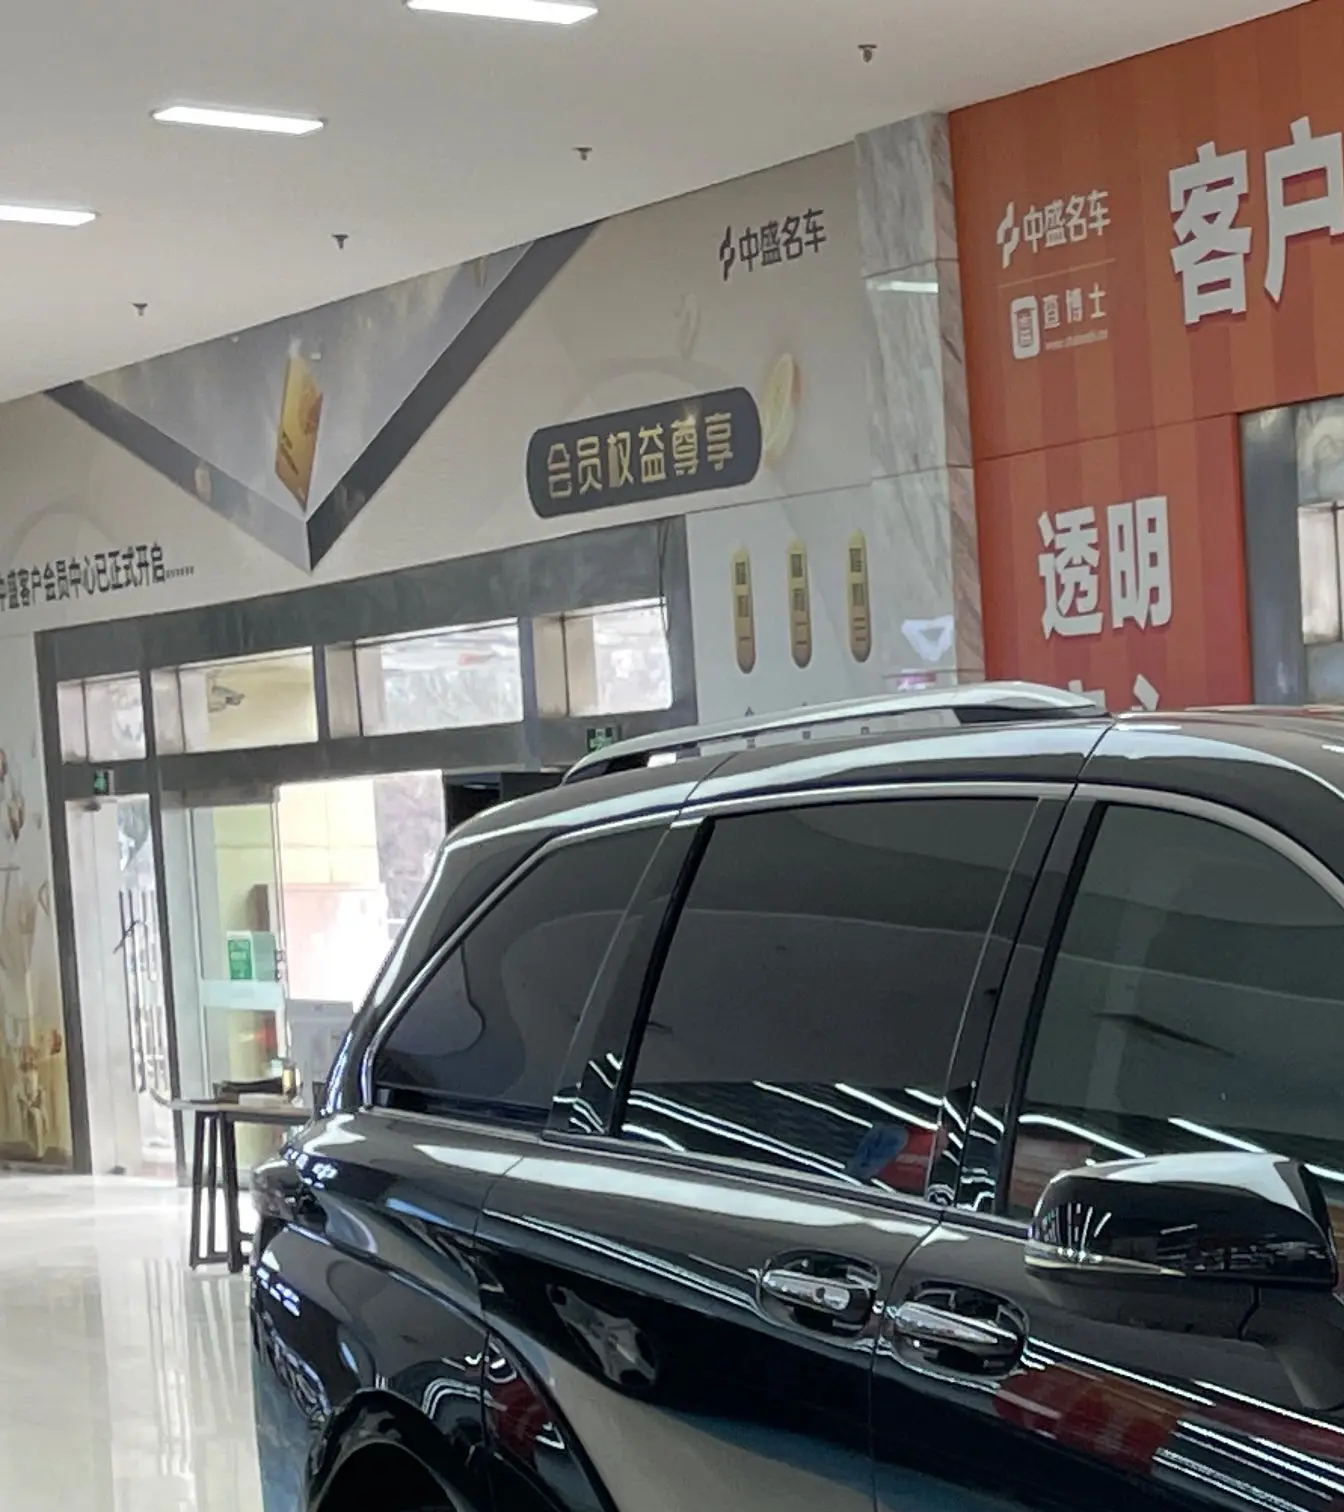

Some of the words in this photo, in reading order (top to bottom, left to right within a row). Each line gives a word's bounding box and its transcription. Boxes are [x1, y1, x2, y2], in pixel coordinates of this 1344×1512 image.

[739, 208, 827, 272] 中盛名车
[1023, 189, 1112, 253] 中盛名车
[547, 412, 734, 498] 会员权益尊享
[1038, 496, 1172, 640] 透明
